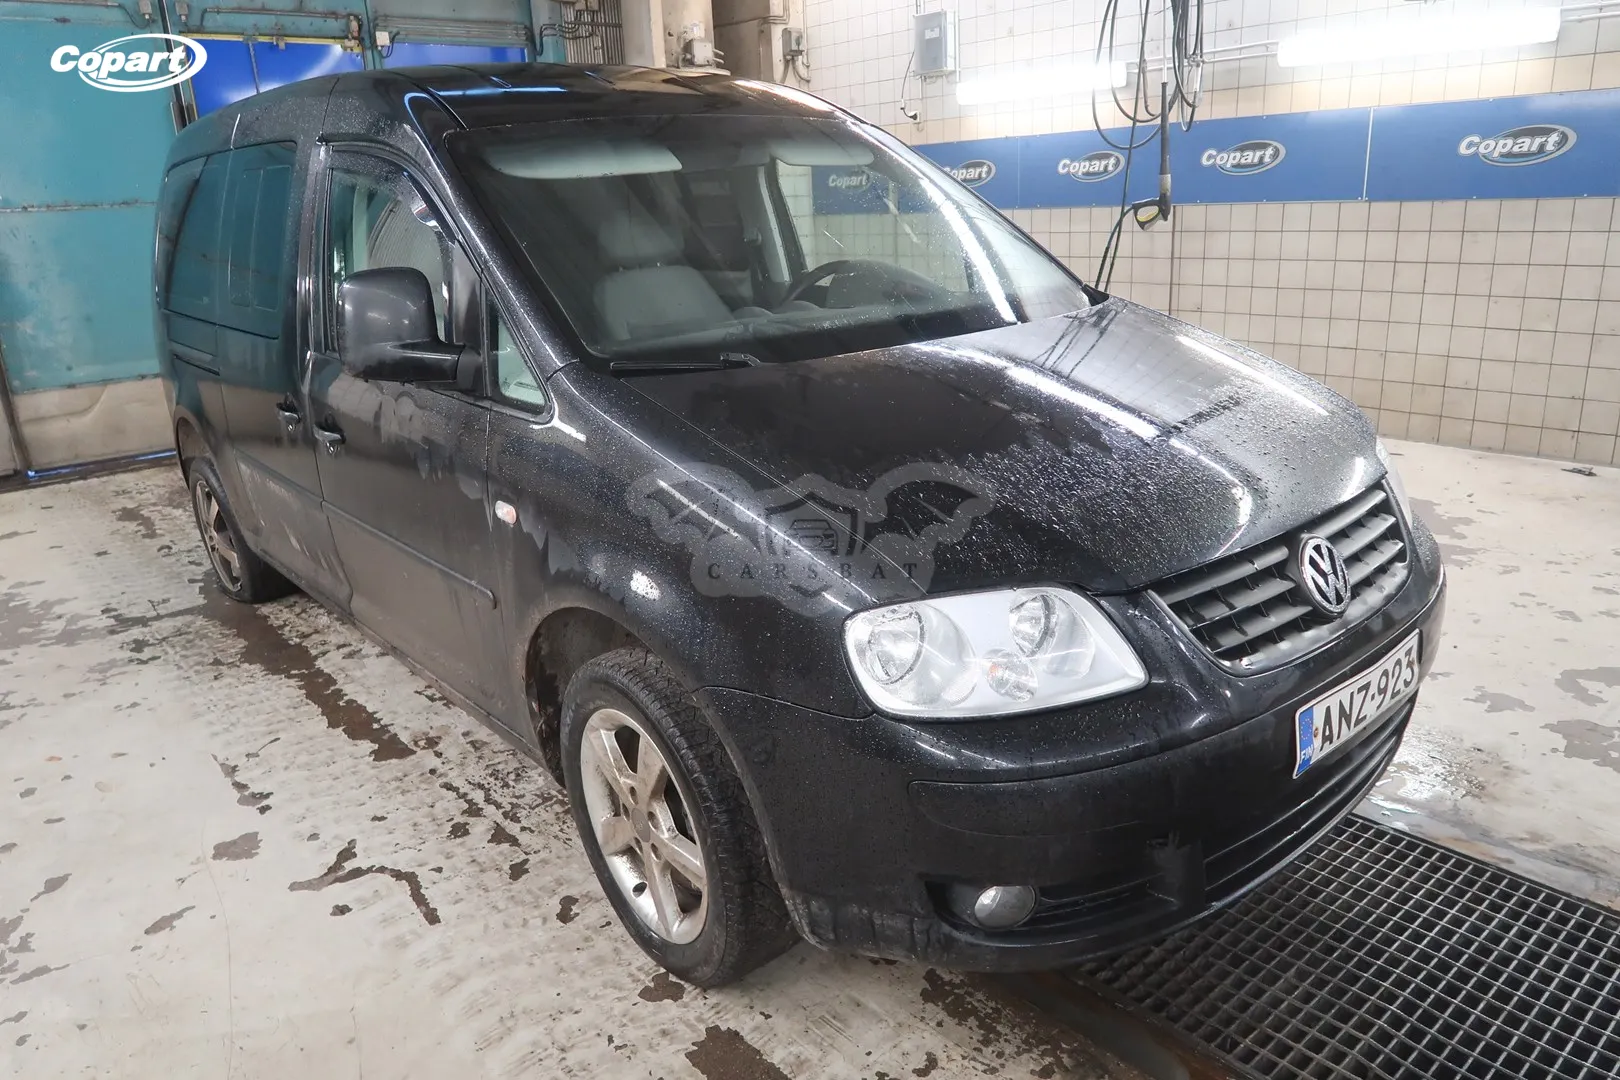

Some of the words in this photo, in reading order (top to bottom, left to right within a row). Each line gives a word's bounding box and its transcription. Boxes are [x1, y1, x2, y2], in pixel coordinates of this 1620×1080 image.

[1458, 133, 1562, 158] Copart
[1058, 156, 1118, 176] Copart
[1201, 145, 1276, 168] Copart
[829, 173, 868, 189] Copart
[943, 165, 989, 180] opart
[1319, 644, 1417, 752] ANZ-923
[1300, 744, 1314, 764] FIN
